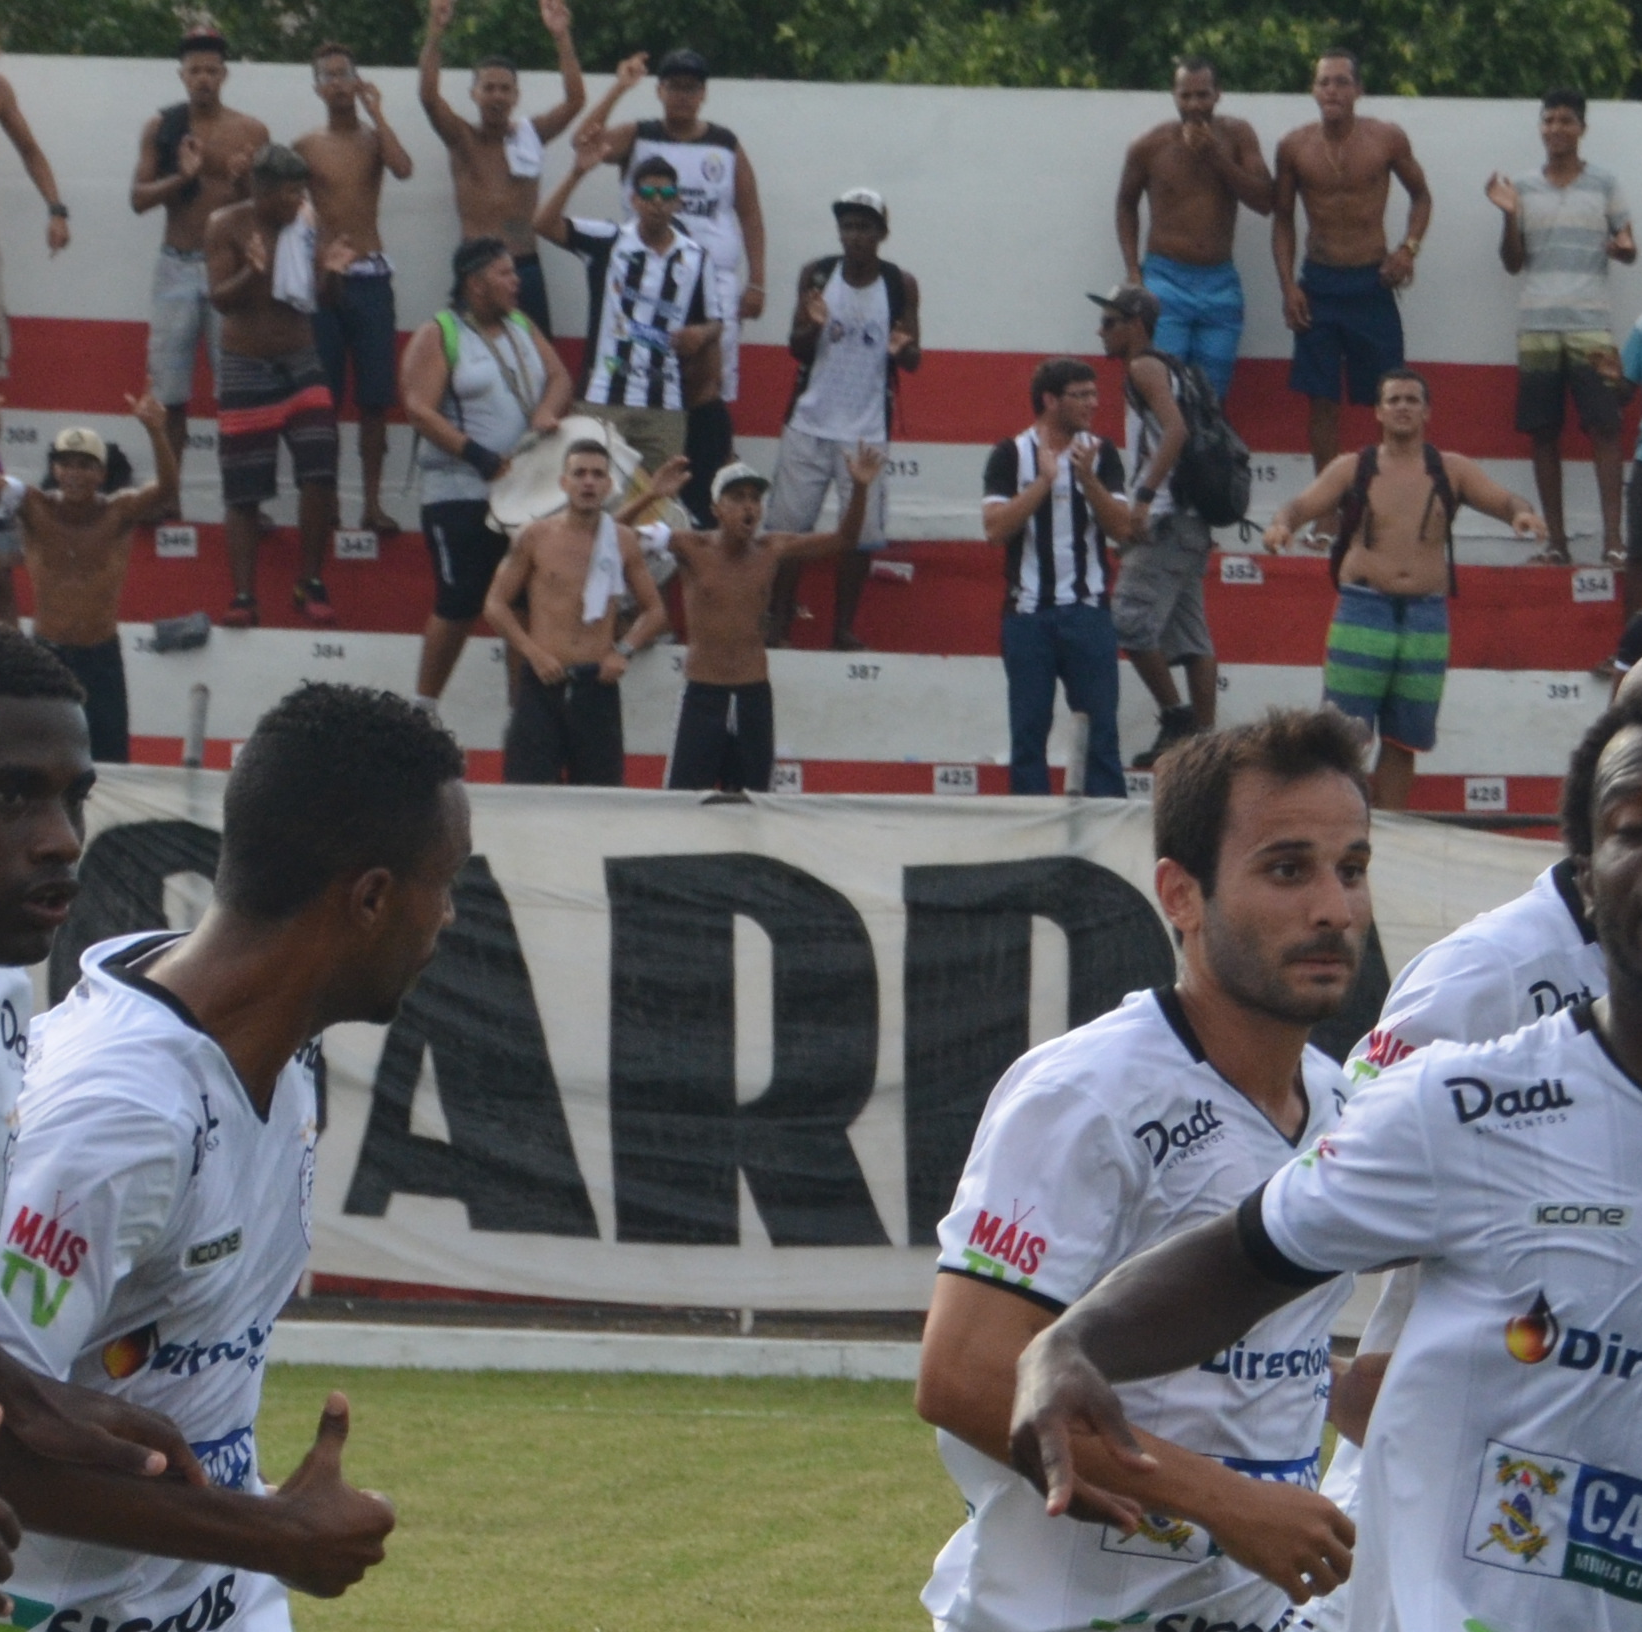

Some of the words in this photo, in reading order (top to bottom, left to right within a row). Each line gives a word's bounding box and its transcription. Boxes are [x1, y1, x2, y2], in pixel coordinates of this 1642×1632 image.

[885, 461, 919, 477] 313
[1253, 467, 1278, 482] 15
[1576, 576, 1610, 593] 354
[312, 643, 345, 659] 384
[847, 665, 880, 680] 387
[1547, 683, 1581, 699] 391
[775, 771, 797, 786] 24
[939, 770, 974, 786] 425
[1127, 776, 1151, 792] 26
[1467, 785, 1503, 802] 428
[1443, 1076, 1574, 1124] Dadi
[1133, 1098, 1224, 1169] Dadi
[6, 1205, 88, 1278] MAIS
[967, 1209, 1047, 1276] MAIS
[0, 1249, 74, 1329] TV
